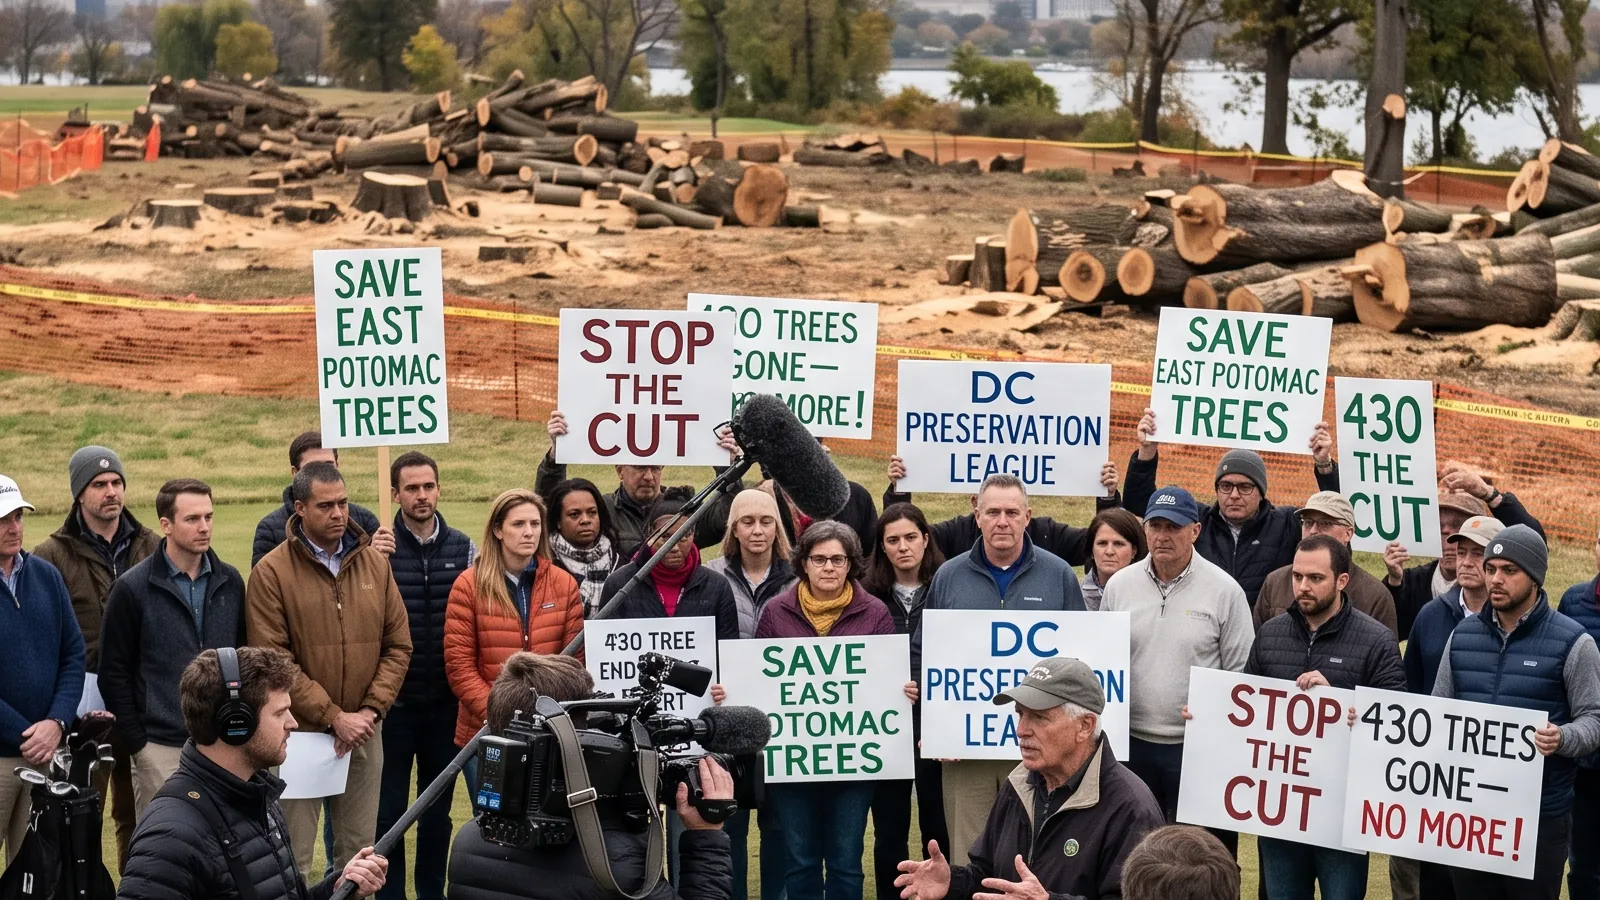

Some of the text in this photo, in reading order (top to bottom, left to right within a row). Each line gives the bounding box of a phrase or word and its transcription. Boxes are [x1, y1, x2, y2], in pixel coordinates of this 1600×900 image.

[334, 258, 422, 299] SAVE
[336, 305, 423, 347] EAST
[579, 318, 715, 365] STOP
[773, 309, 858, 344] TREES
[1186, 316, 1289, 358] SAVE
[322, 353, 441, 389] POTOMAC
[605, 373, 683, 406] THE
[971, 370, 1036, 405] DC
[1156, 358, 1320, 396] EAST POTOMAC
[332, 394, 438, 438] TREES
[587, 412, 700, 458] CUT
[906, 411, 1102, 446] PRESERVATION
[1171, 394, 1289, 444] TREES
[1343, 392, 1422, 444] 430
[950, 453, 1056, 486] LEAGUE
[1352, 451, 1414, 486] THE
[1349, 492, 1430, 543] CUT
[648, 631, 696, 650] TREE
[991, 621, 1060, 658] DC
[762, 643, 867, 678] SAVE
[780, 680, 860, 706] EAST
[1227, 683, 1342, 739] STOP
[766, 709, 900, 738] OTOMAC
[965, 713, 1020, 747] LEA
[1360, 702, 1537, 763] 430 TREES
[763, 742, 883, 777] TREES
[1246, 738, 1312, 777] THE
[1223, 775, 1322, 832] CUT
[1361, 799, 1524, 862] NO MORE!
